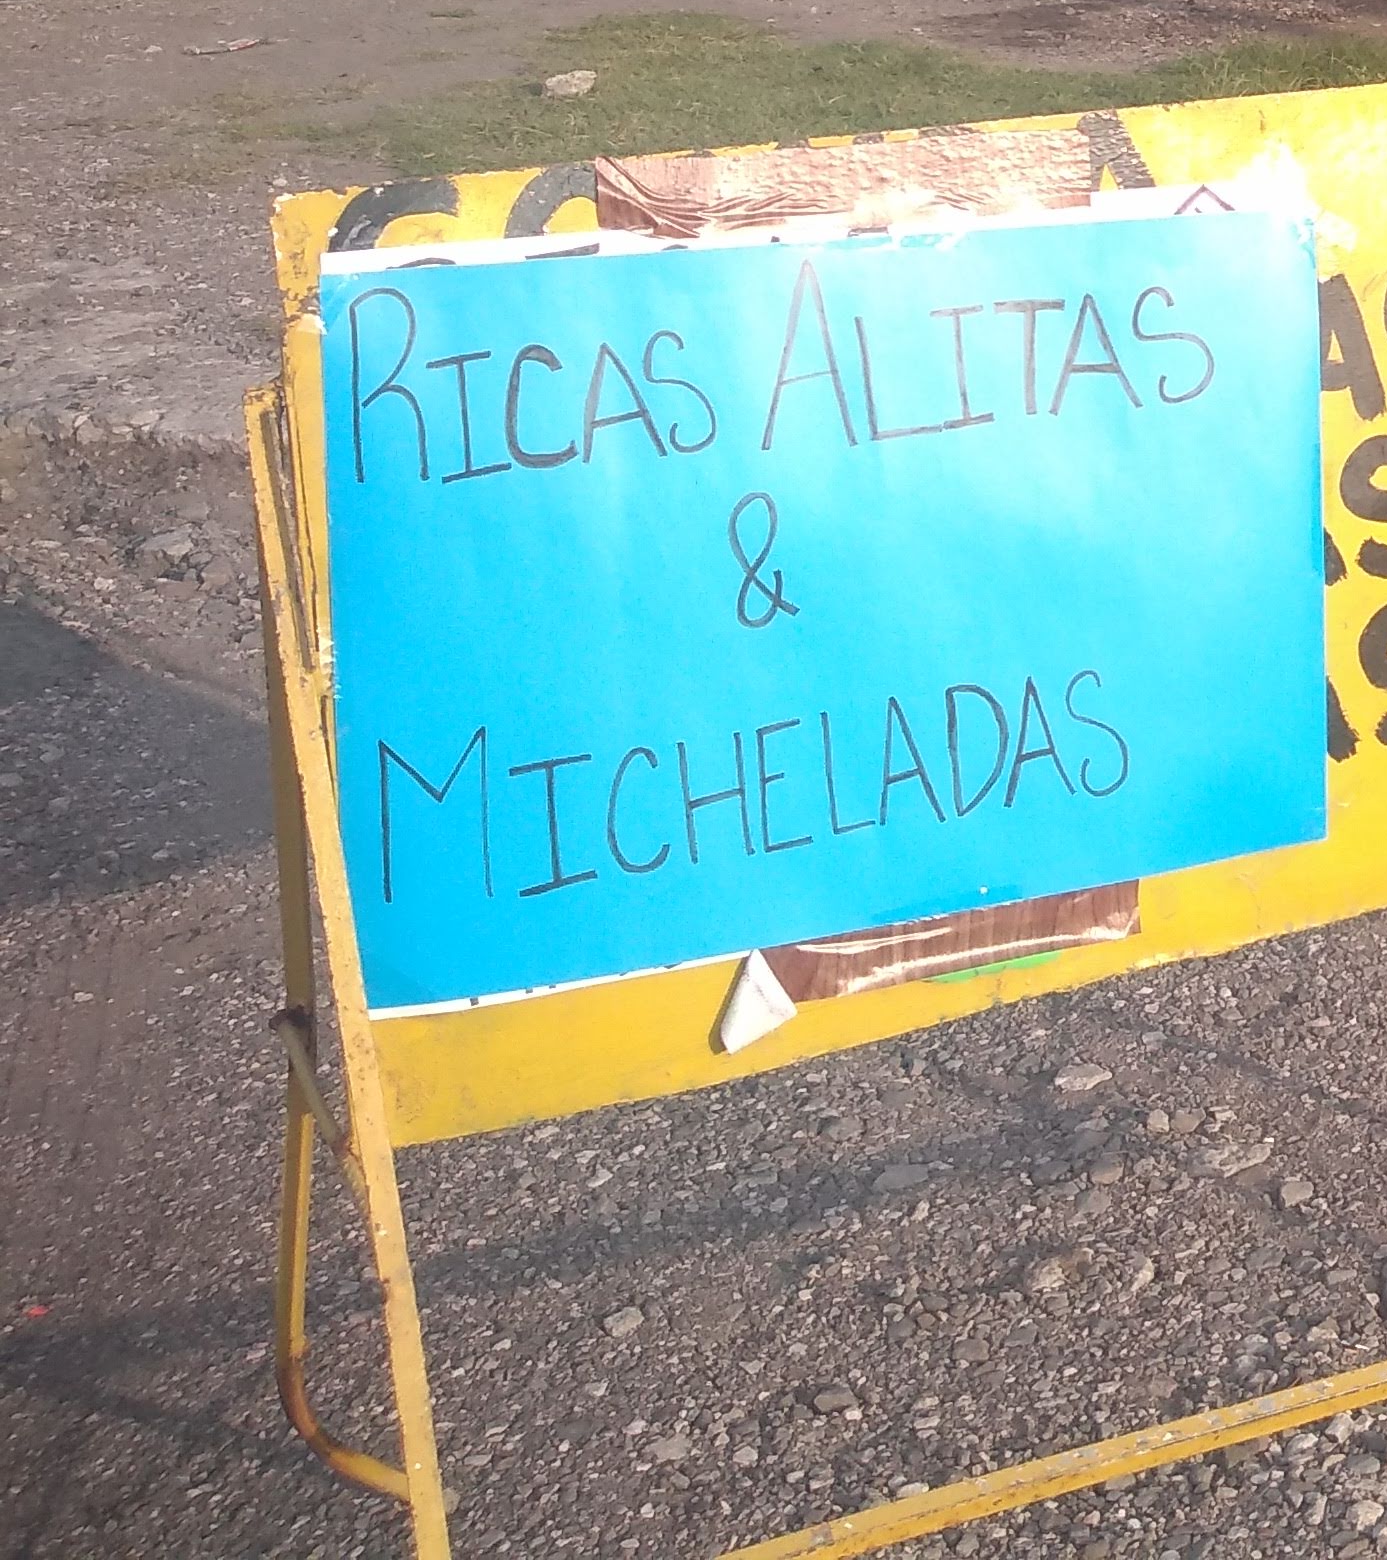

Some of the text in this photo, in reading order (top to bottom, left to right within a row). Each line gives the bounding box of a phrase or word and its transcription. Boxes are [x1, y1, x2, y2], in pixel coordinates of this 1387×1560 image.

[348, 258, 1216, 486] RICAS ALITAS
[726, 492, 800, 629] &
[378, 669, 1130, 905] MICHELADAS
